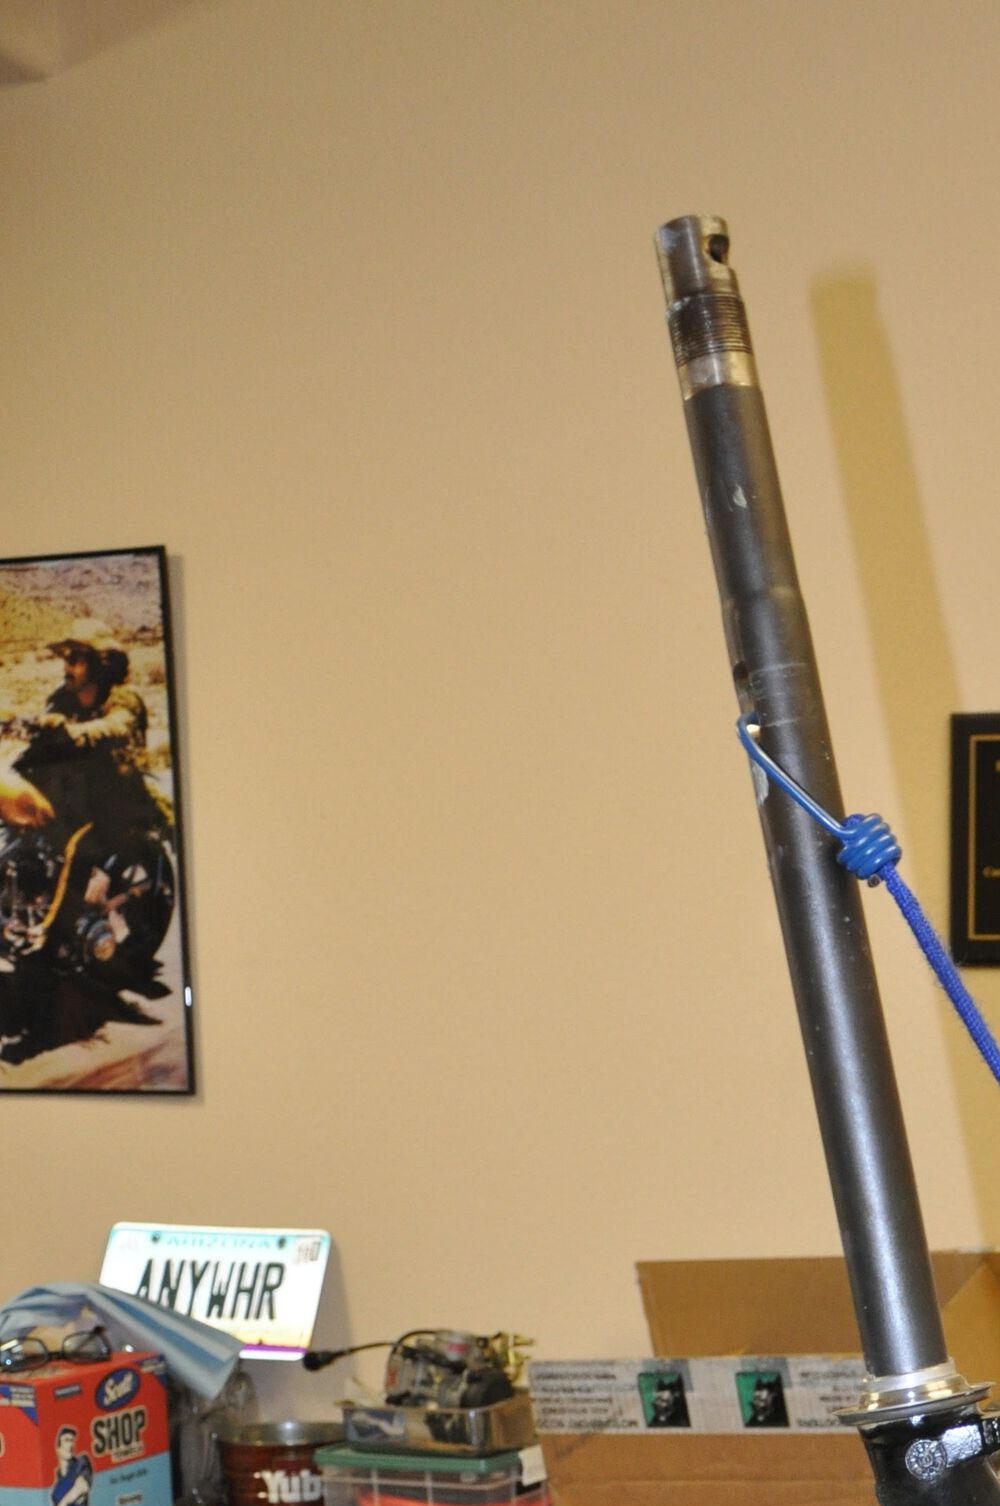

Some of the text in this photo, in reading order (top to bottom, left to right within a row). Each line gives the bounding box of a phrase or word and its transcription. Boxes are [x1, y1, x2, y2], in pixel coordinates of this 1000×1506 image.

[136, 1258, 286, 1320] ANYWHR
[93, 1409, 146, 1454] SHOP
[261, 1470, 322, 1503] Yub
